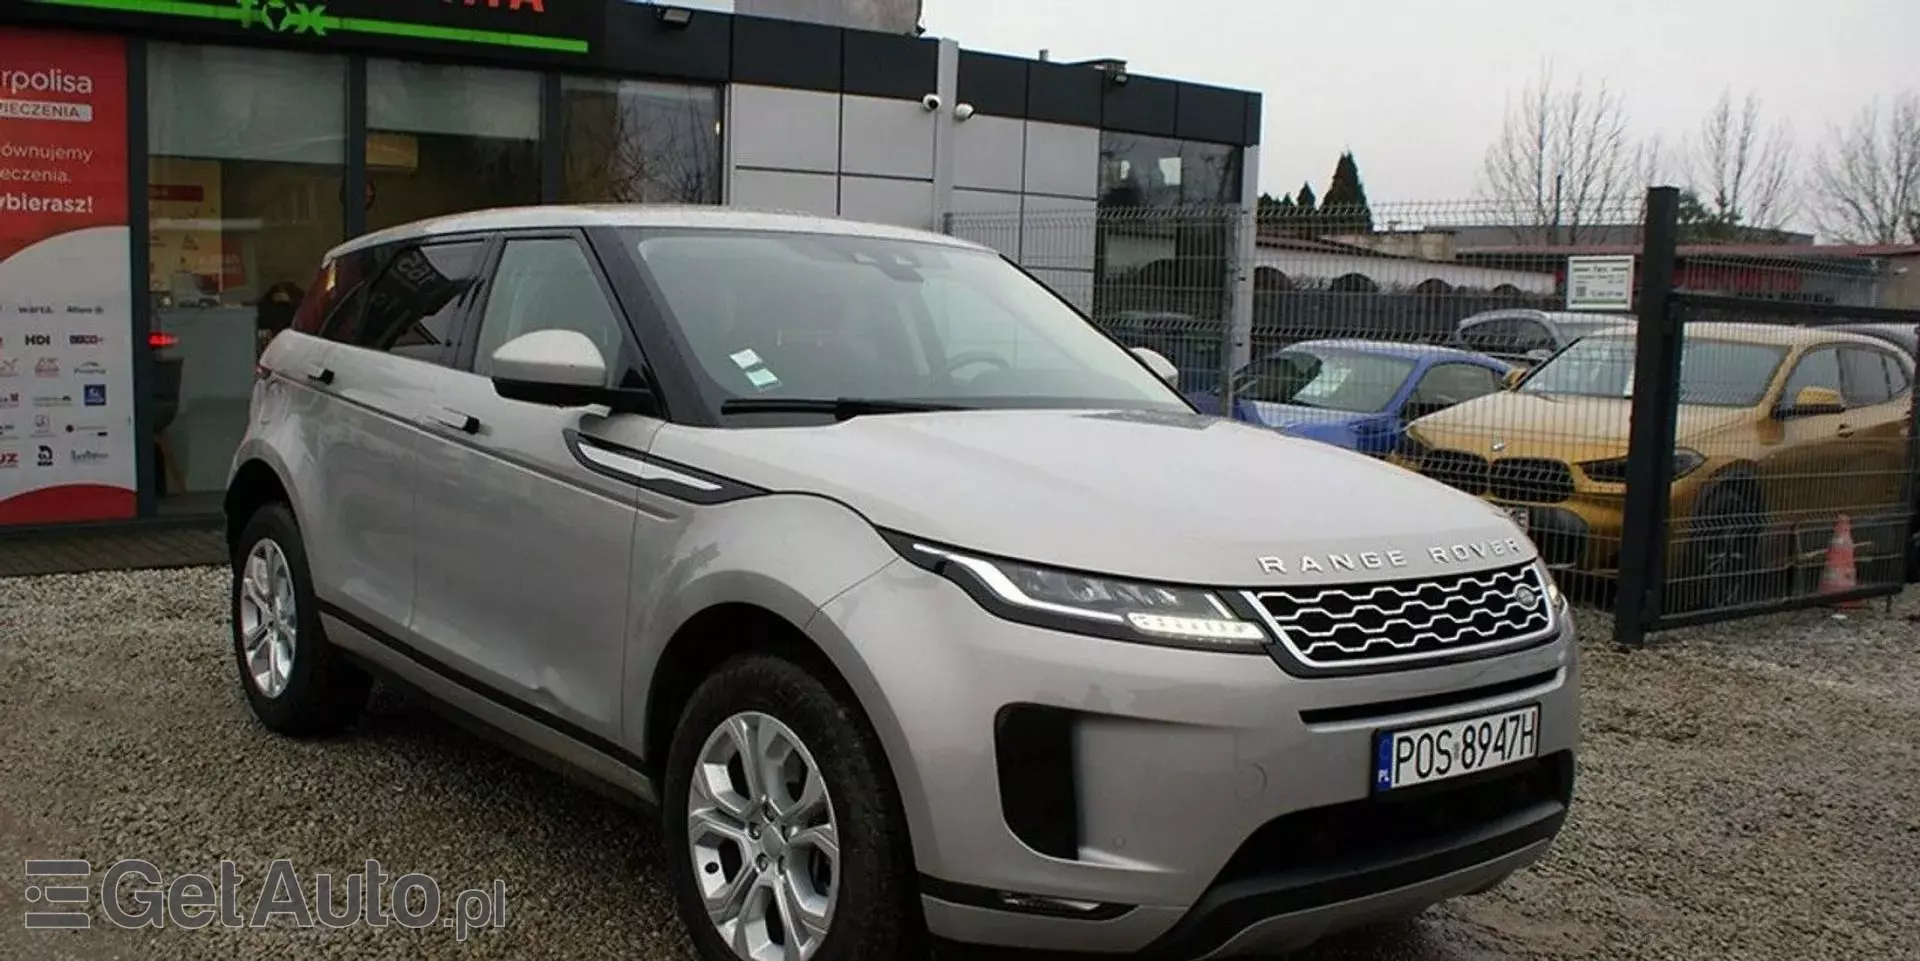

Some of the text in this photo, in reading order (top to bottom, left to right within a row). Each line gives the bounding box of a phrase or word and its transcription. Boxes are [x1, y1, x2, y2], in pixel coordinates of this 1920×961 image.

[2, 142, 93, 163] ównujemy
[25, 334, 50, 346] HDI
[1257, 537, 1521, 574] RANGE ROVER
[1395, 711, 1535, 784] POS 8947H
